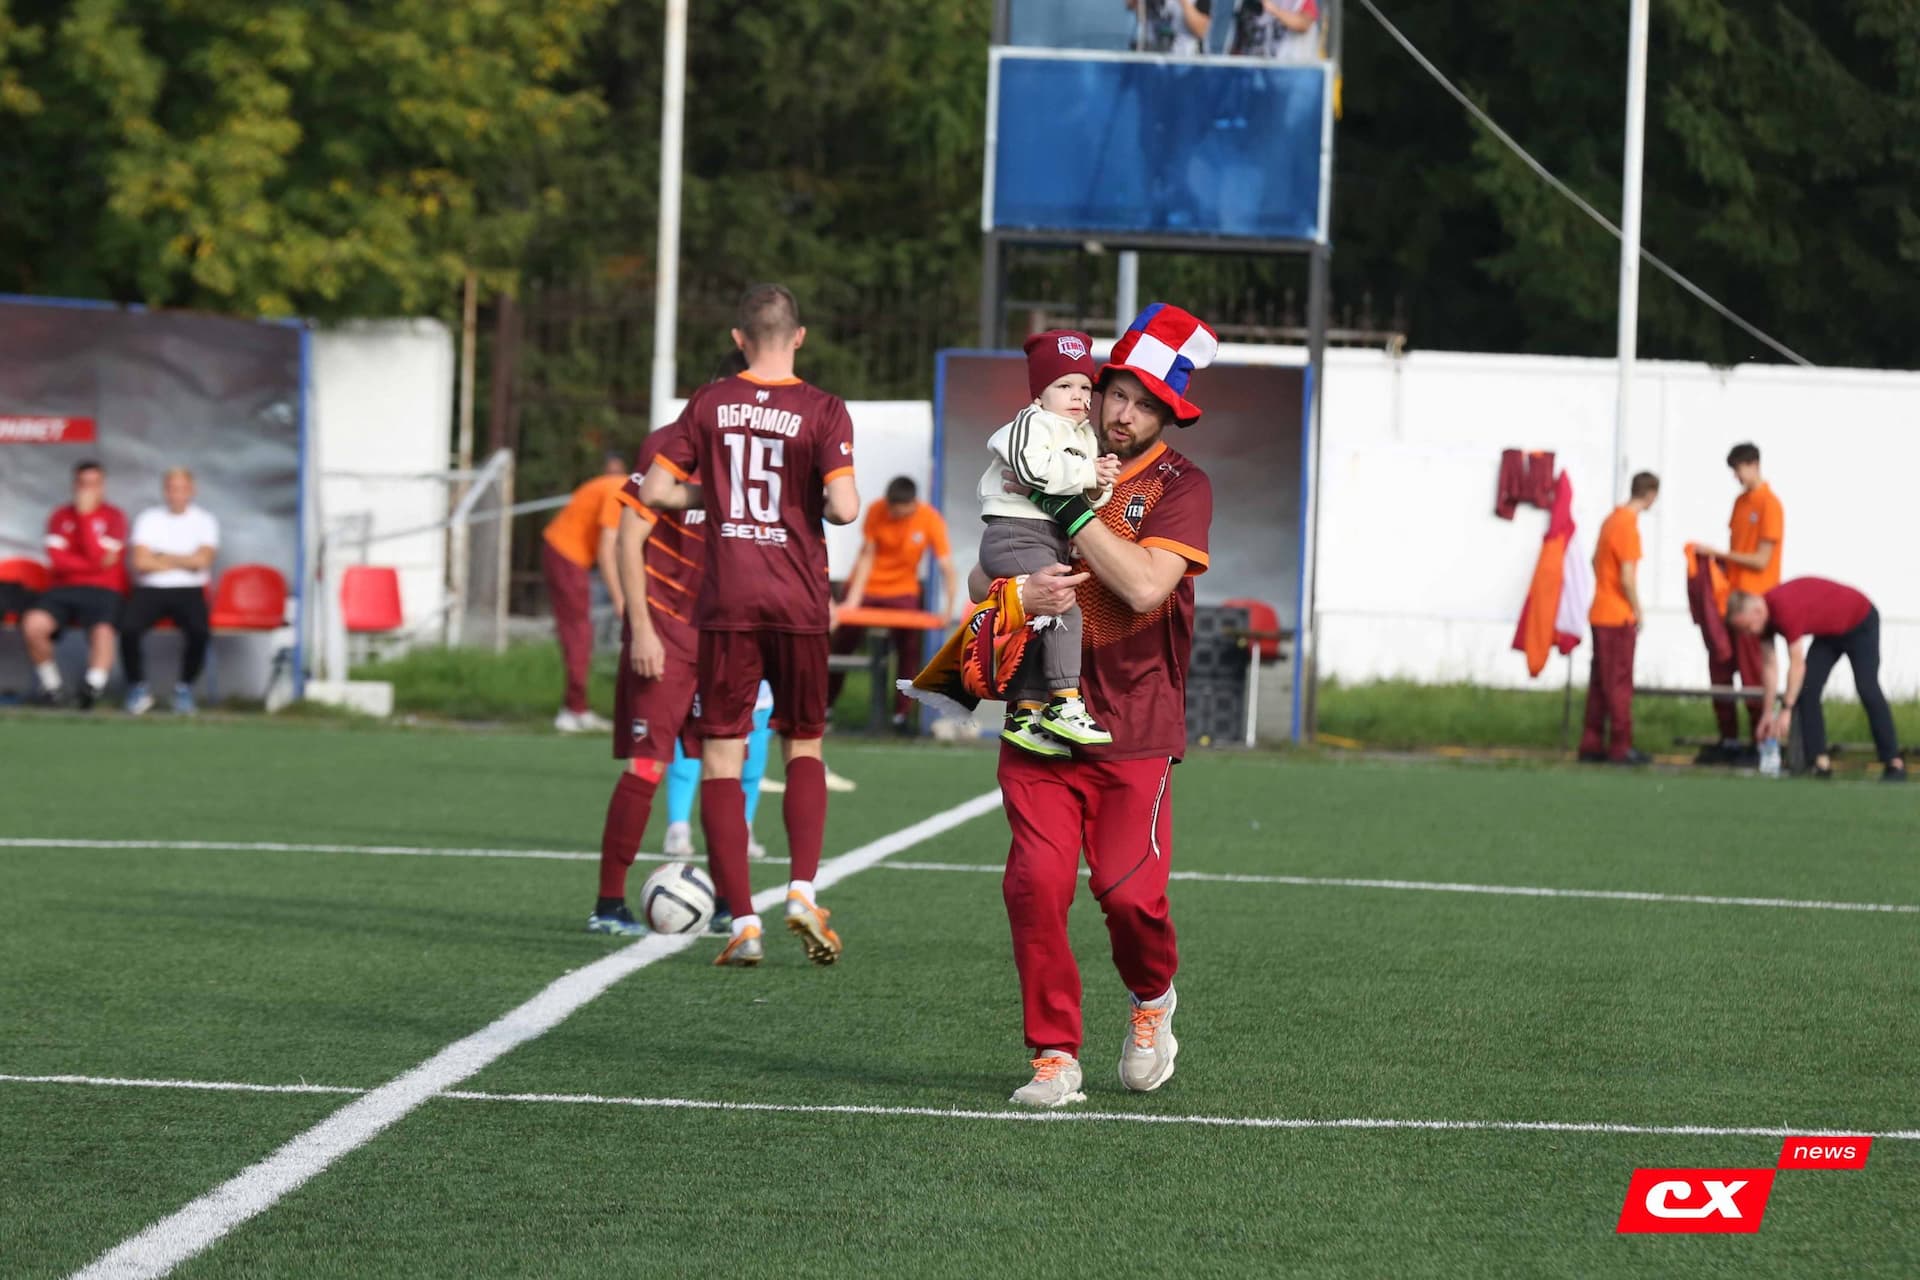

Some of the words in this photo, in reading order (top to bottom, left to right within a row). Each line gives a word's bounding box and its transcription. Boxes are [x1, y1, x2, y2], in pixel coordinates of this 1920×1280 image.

[717, 404, 802, 437] АБРАМОВ
[724, 433, 784, 523] 15
[720, 522, 788, 543] SEUS
